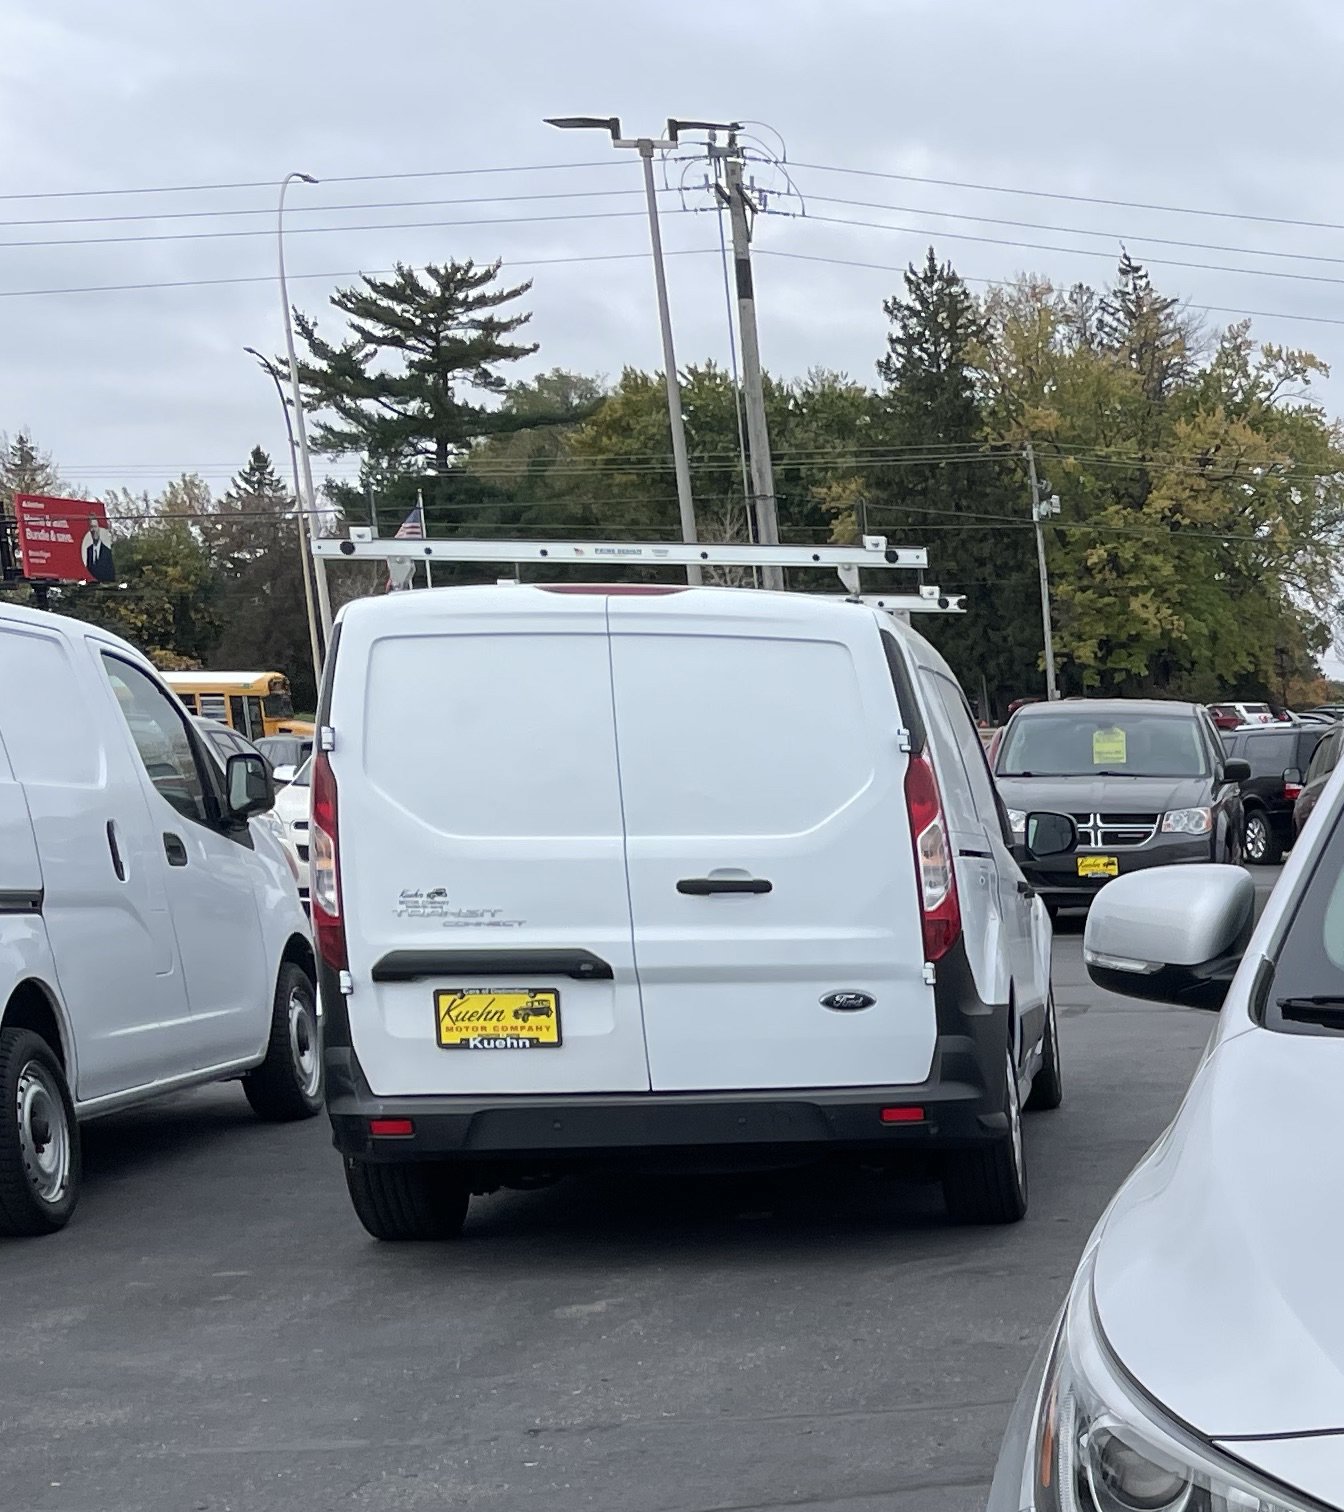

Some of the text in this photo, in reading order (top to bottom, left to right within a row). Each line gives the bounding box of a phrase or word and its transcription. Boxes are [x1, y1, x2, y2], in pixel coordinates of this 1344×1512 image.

[392, 908, 503, 918] TRANSIT
[440, 997, 506, 1026] Kuehn
[445, 1025, 552, 1033] MOTOR COMPANY
[469, 1037, 530, 1049] Kuehn
